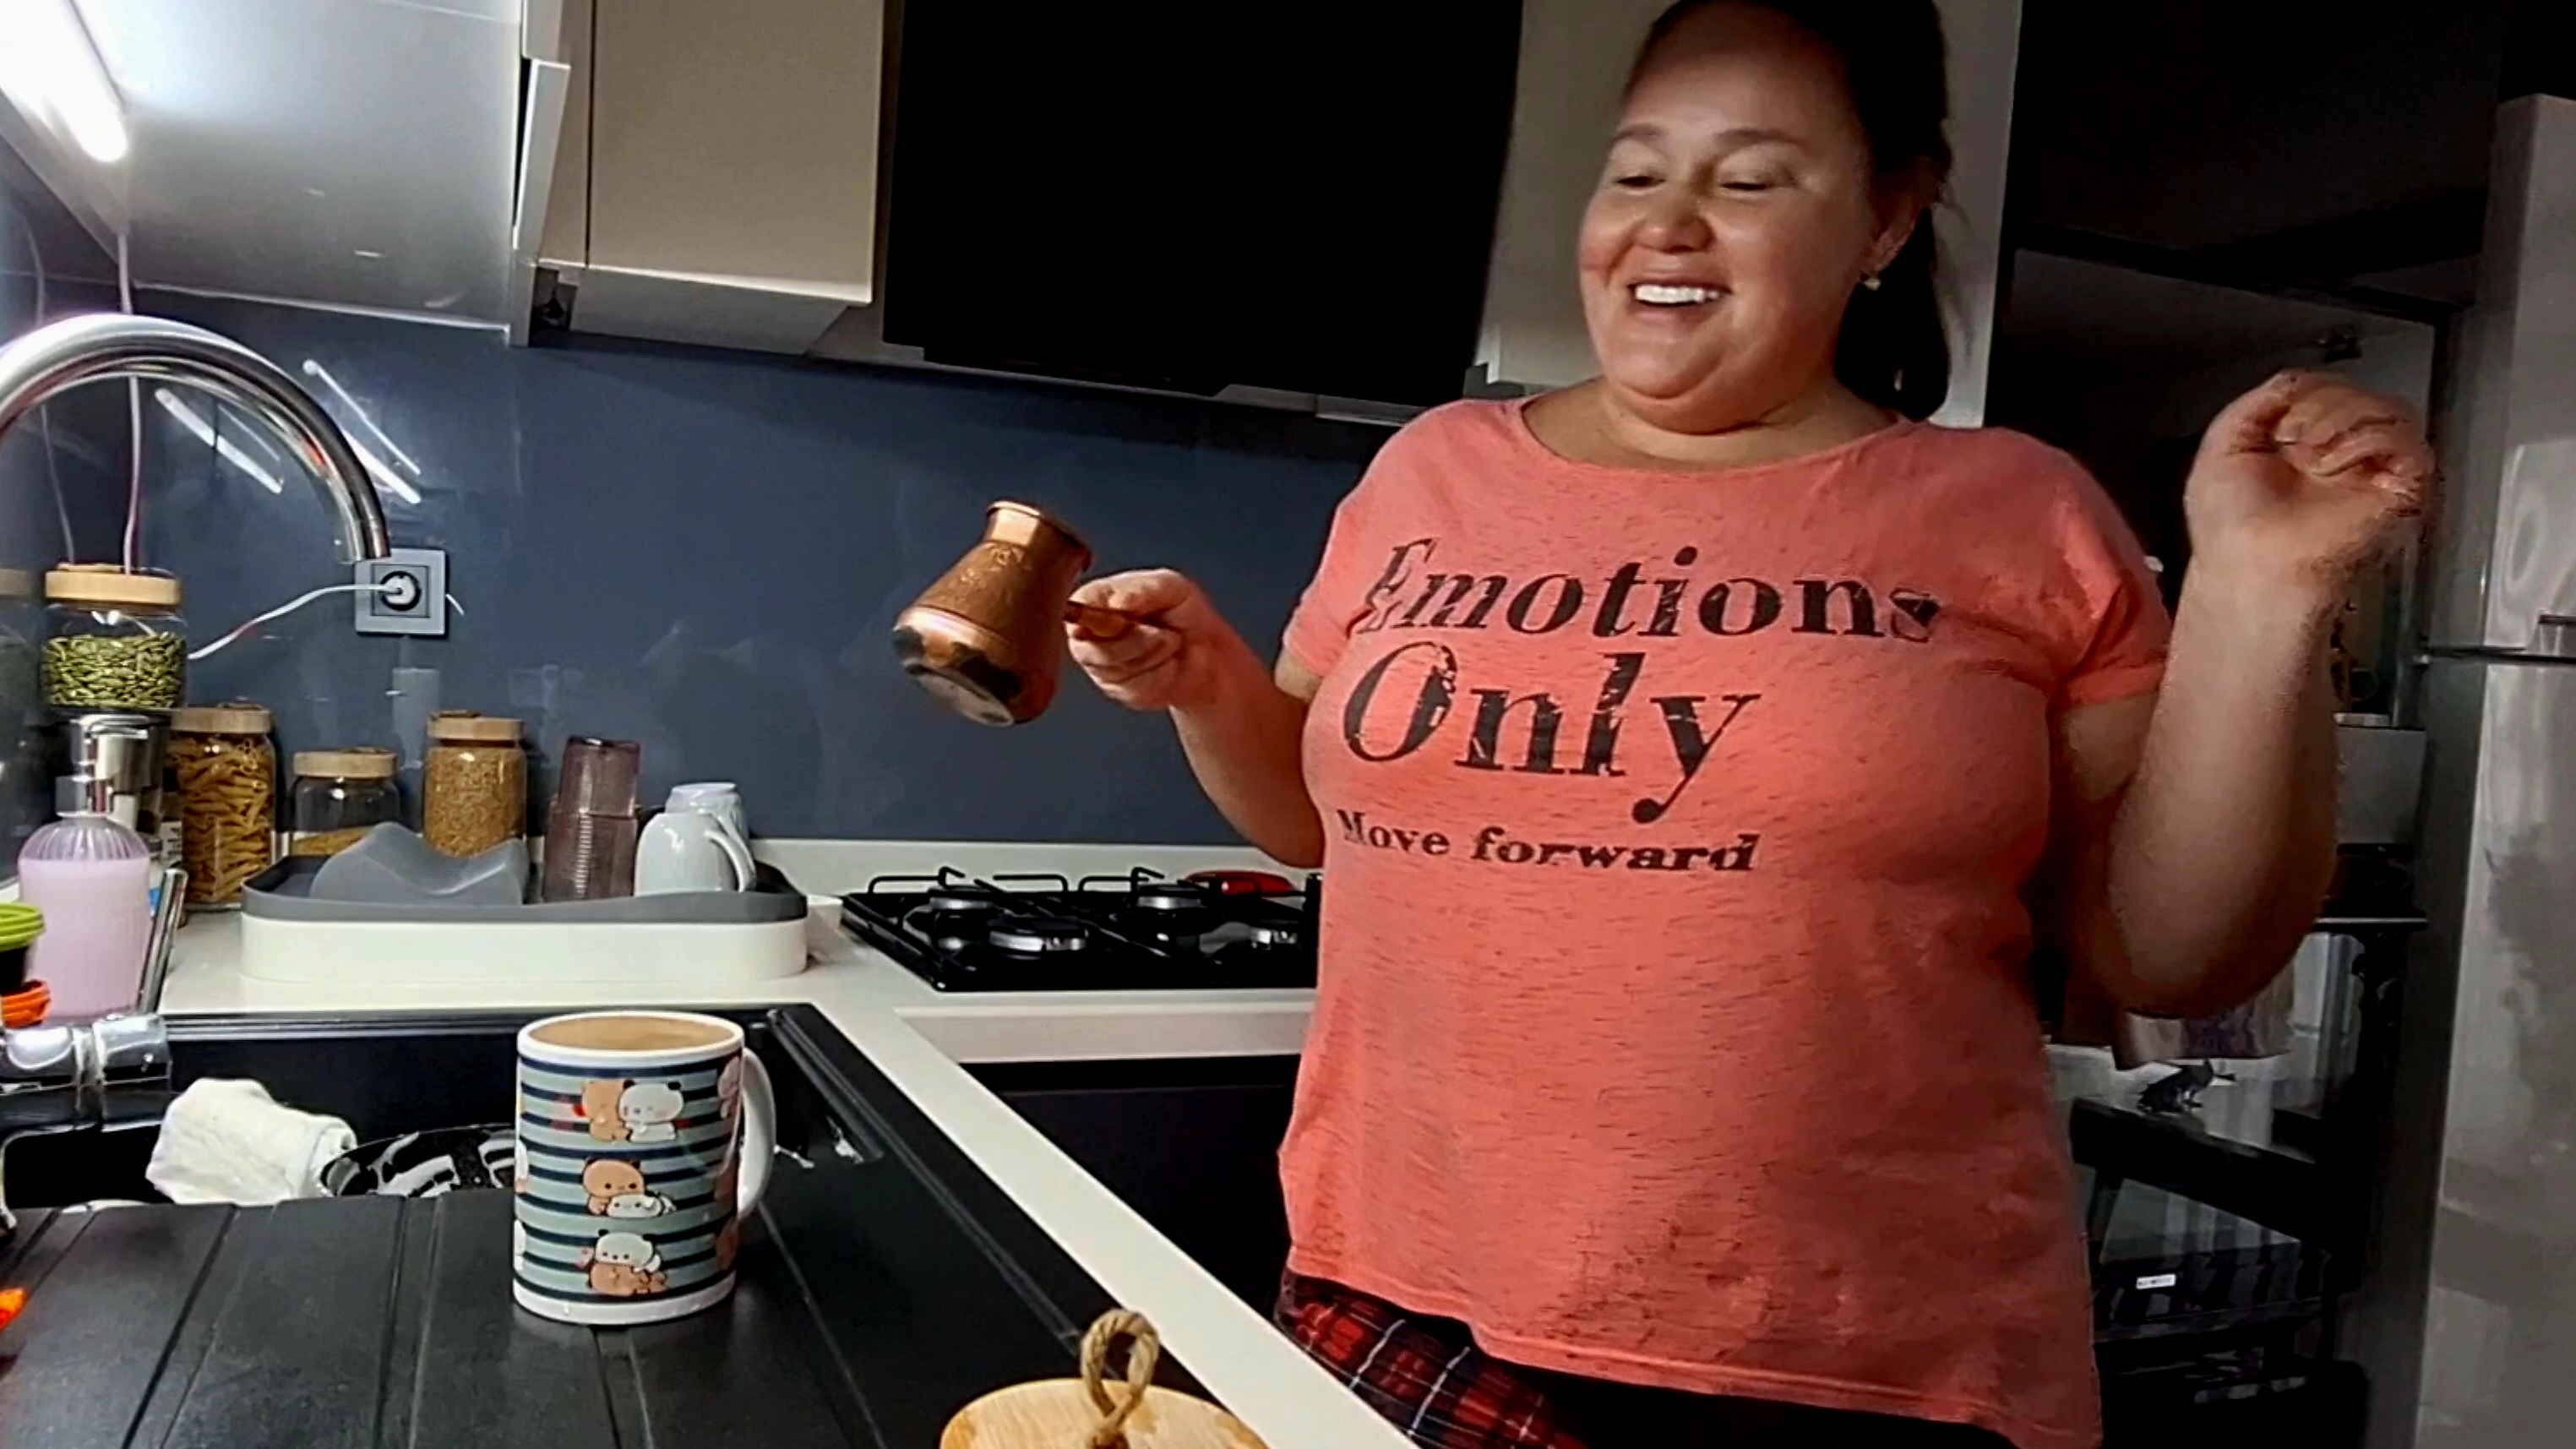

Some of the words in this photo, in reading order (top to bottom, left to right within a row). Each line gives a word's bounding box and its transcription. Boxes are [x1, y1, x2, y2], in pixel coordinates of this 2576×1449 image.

[1356, 538, 1941, 643] Emotions
[1343, 640, 1762, 825] Only
[1337, 809, 1451, 857] Move
[1470, 827, 1761, 872] forward
